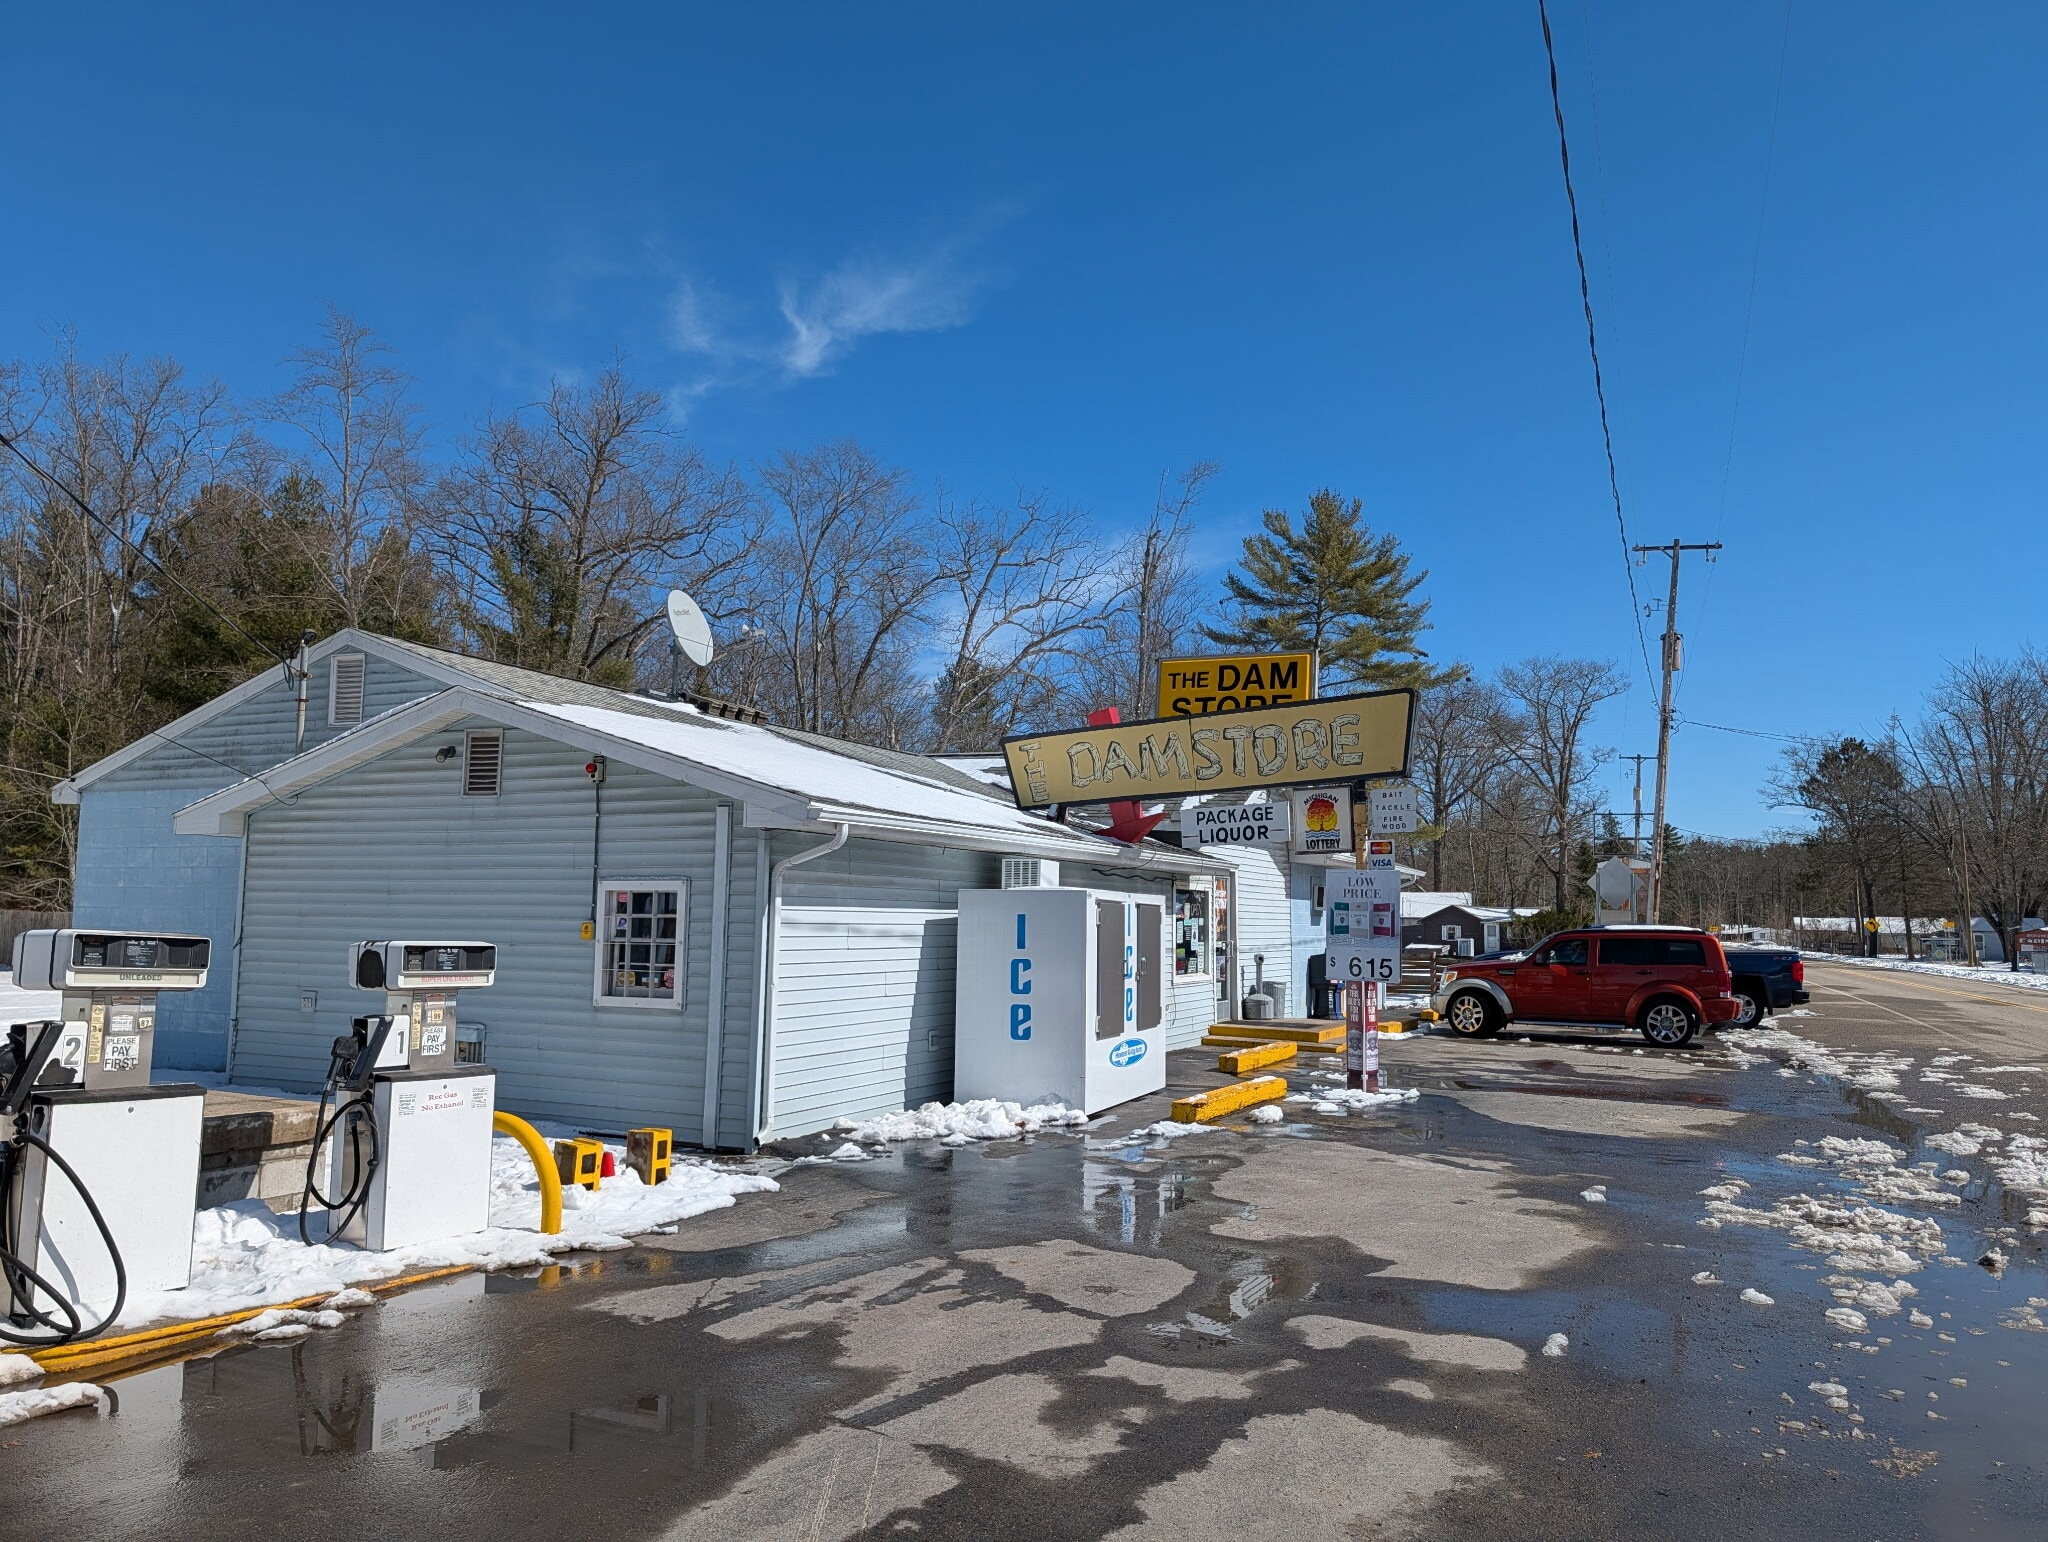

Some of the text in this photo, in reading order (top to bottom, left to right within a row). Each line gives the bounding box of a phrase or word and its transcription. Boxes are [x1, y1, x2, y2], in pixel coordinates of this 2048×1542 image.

[1168, 661, 1299, 692] THE DAM
[1303, 792, 1340, 806] MICHIGAN
[1382, 791, 1403, 799] BAIT
[1376, 804, 1412, 812] TACKLE
[1196, 806, 1274, 826] PACKAGE
[1383, 815, 1404, 823] FIRE
[1381, 822, 1407, 831] WOOD
[1199, 825, 1270, 845] LIQUOR
[1306, 837, 1341, 850] LOTTERY
[1372, 859, 1393, 867] VISA
[1348, 877, 1376, 887] LOW
[1343, 888, 1382, 899] PRICE
[1330, 956, 1393, 979] $ 6.15
[140, 1019, 149, 1027] 87
[398, 1031, 404, 1054] 1
[427, 1035, 440, 1043] PAY
[65, 1037, 81, 1066] 2
[112, 1046, 131, 1056] PAY
[422, 1045, 444, 1054] FIRST
[104, 1058, 137, 1069] FIRST
[434, 1100, 464, 1110] Ethanol
